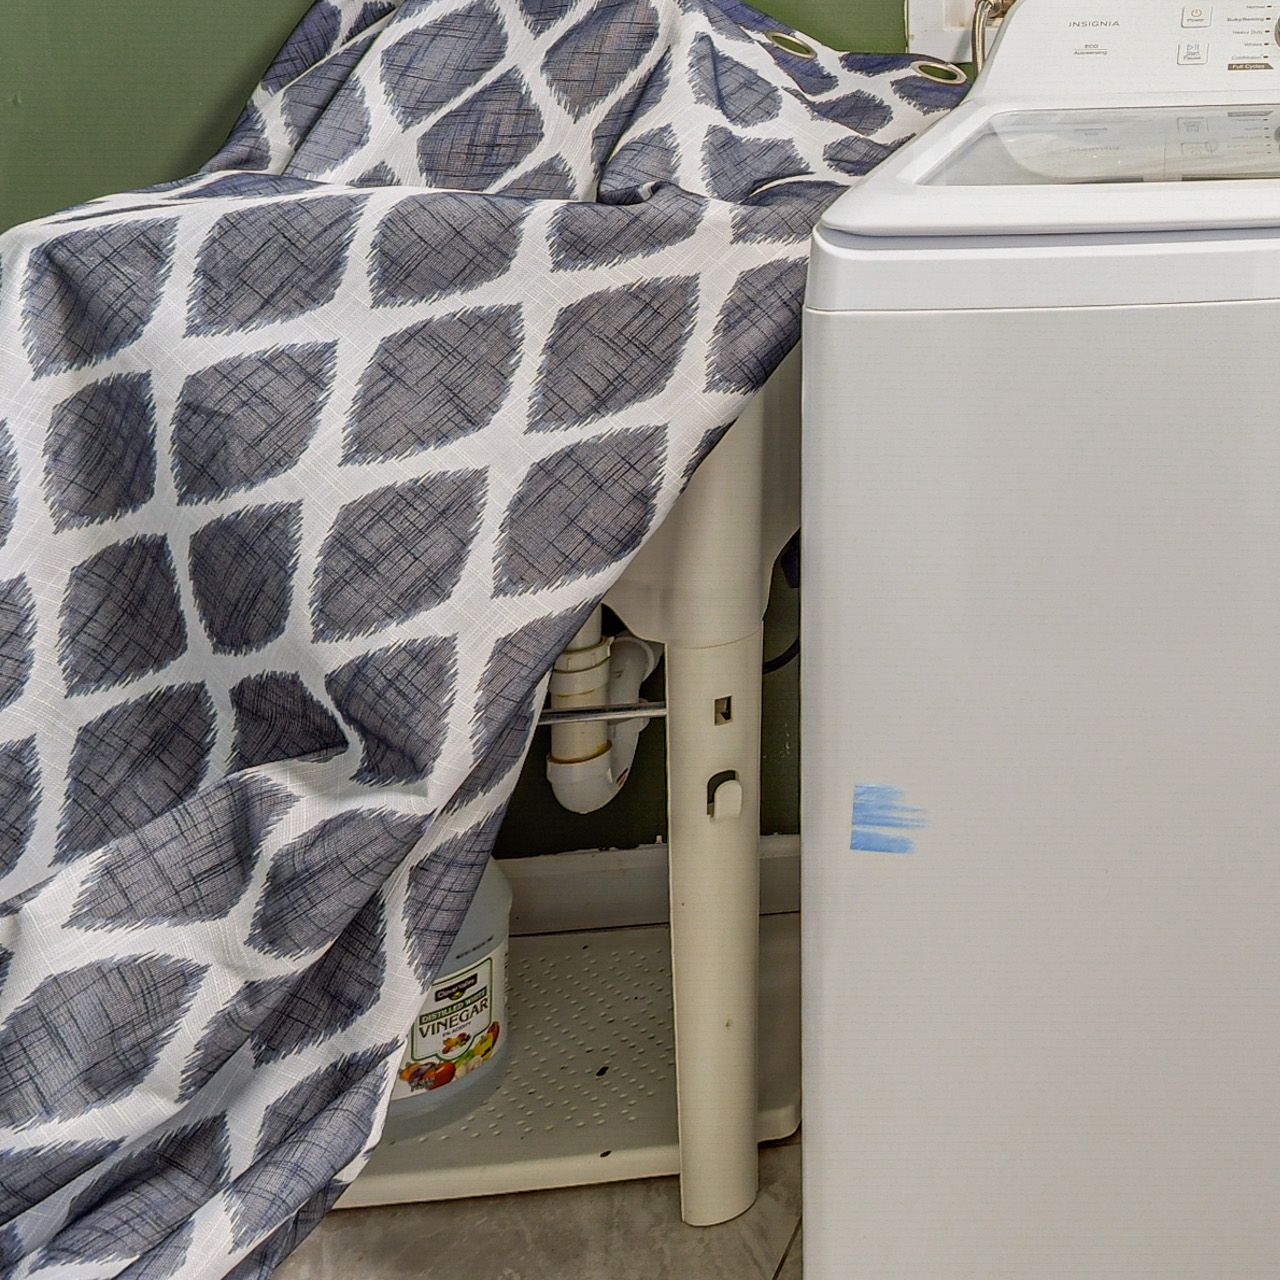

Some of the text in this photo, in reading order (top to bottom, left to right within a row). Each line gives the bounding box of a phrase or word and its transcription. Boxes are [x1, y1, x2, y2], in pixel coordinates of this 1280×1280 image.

[1069, 20, 1120, 28] INSIGNIA
[419, 998, 489, 1038] VINEGAR
[421, 1002, 464, 1022] DISTILLED
